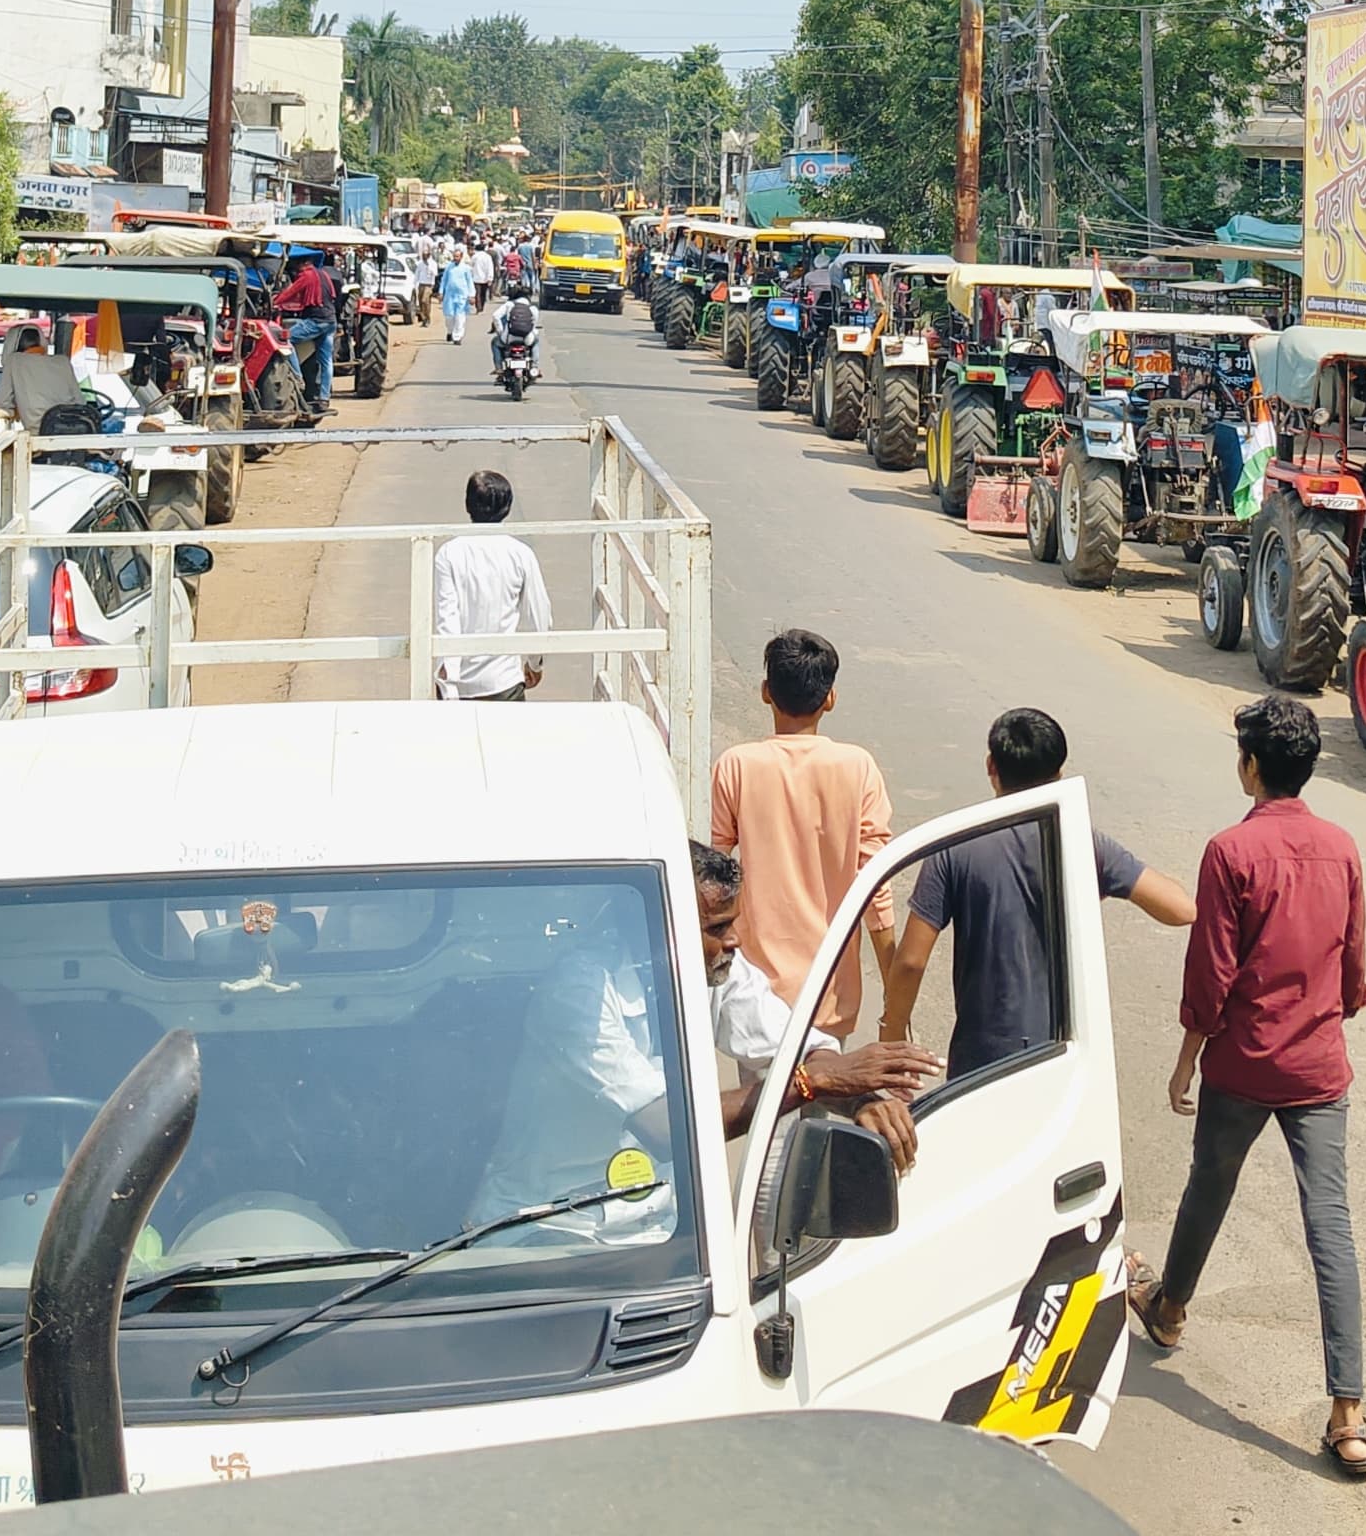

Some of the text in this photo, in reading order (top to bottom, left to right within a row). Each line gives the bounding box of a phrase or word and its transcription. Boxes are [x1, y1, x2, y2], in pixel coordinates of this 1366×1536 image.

[17, 177, 89, 197] जनता कार
[1006, 1281, 1069, 1403] MEGA
